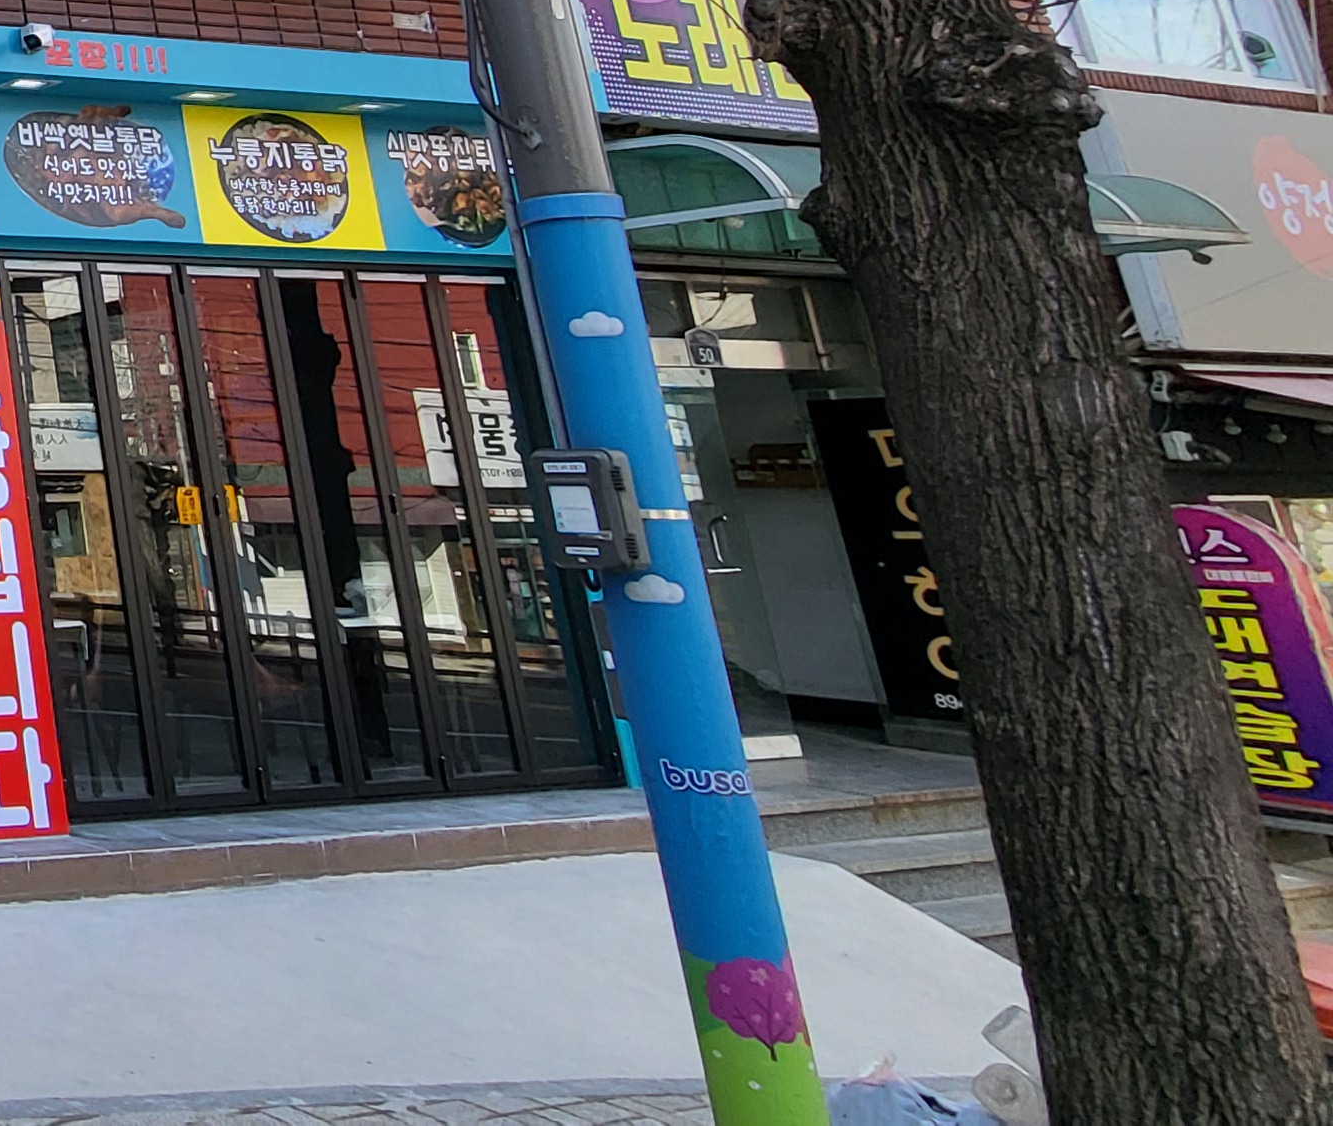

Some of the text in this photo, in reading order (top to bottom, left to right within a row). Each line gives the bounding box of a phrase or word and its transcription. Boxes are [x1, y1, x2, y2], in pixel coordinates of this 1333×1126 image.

[17, 122, 164, 156] 바싹옛날통닭
[207, 136, 348, 172] 누룽지통닭
[44, 156, 149, 180] 식어도 맛있는
[229, 177, 274, 195] 바삭한
[233, 197, 260, 214] 통닭
[698, 347, 715, 364] 50
[659, 758, 752, 795] busa
